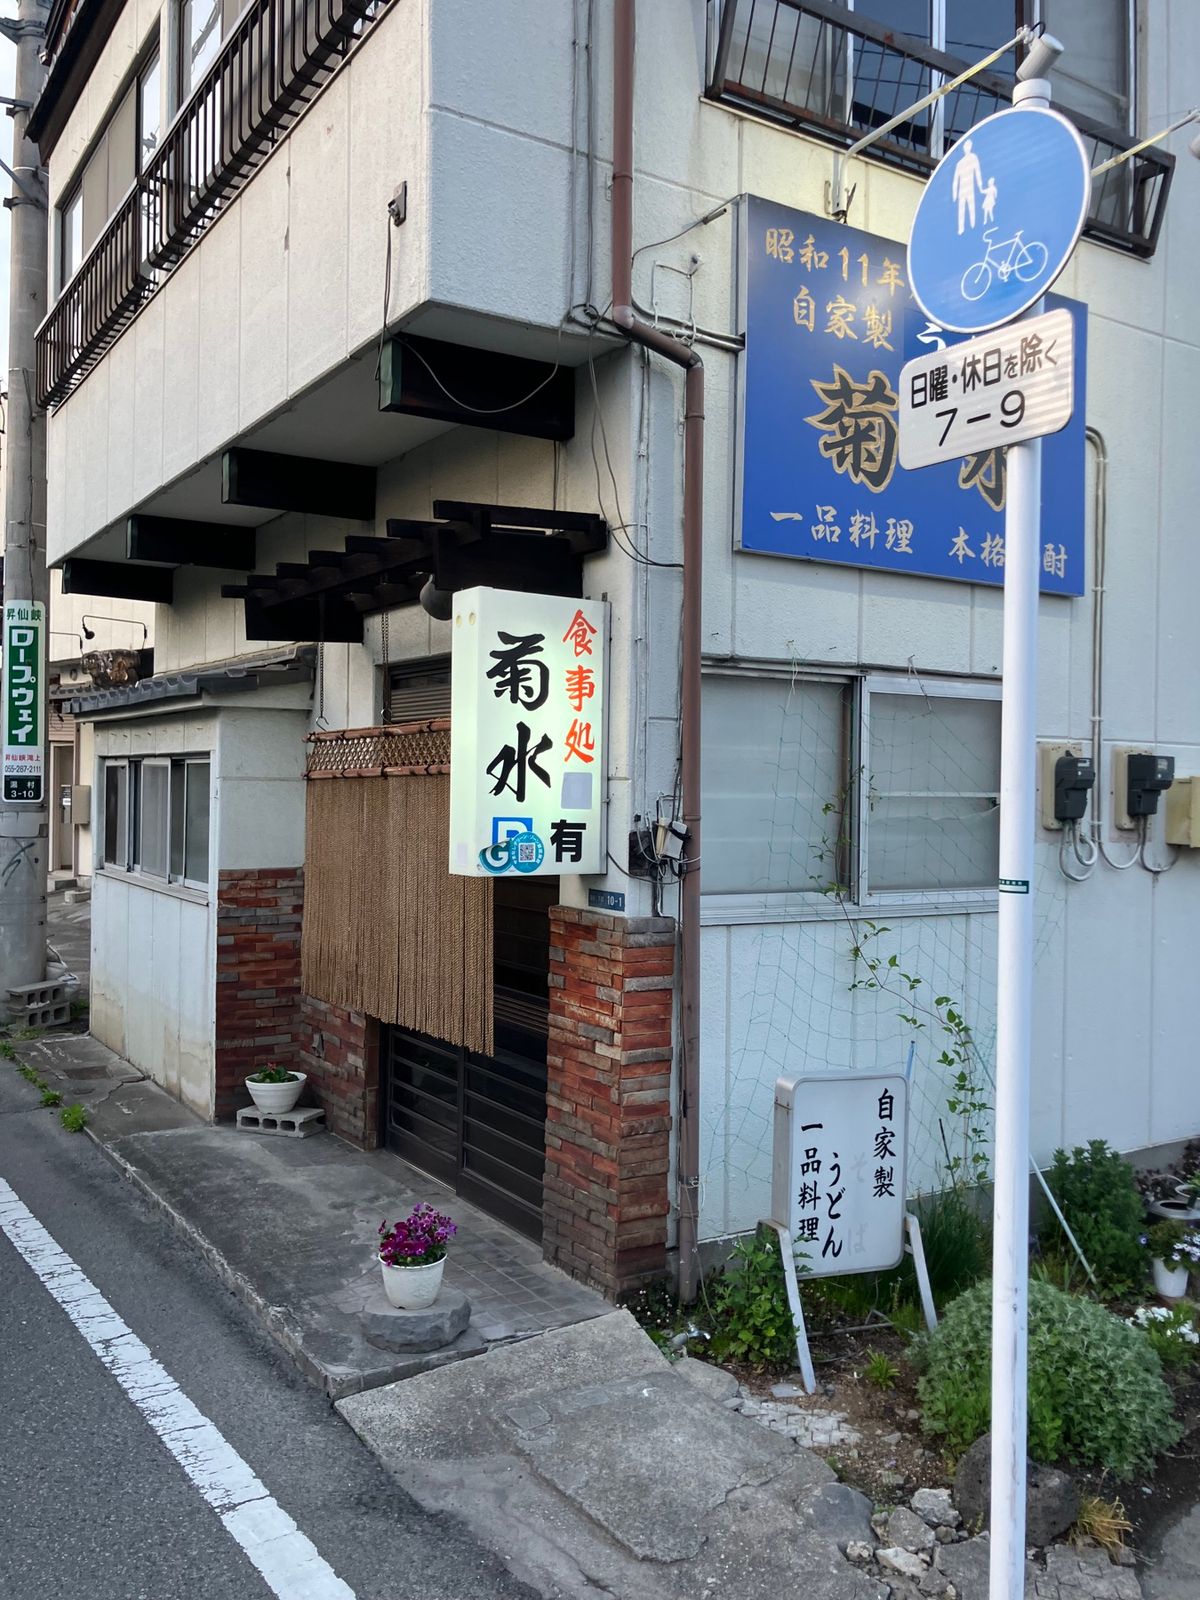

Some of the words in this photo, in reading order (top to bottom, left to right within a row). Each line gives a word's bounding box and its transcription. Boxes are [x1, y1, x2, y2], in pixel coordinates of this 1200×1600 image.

[766, 228, 905, 296] 昭和11年
[793, 286, 896, 352] 自家製
[911, 333, 1058, 409] 日曜・休日を除く
[769, 504, 914, 555] 一品料理
[948, 526, 1068, 580] 本格酎
[7, 608, 42, 621] 昇仙峡
[11, 628, 37, 744] ロープウェイ
[486, 630, 553, 803] 菊水
[562, 609, 598, 764] 食事処
[10, 790, 34, 798] 3-10
[550, 819, 587, 863] 有
[873, 1087, 897, 1198] 自家製
[798, 1122, 824, 1242] 一品料理
[822, 1151, 846, 1259] うどん
